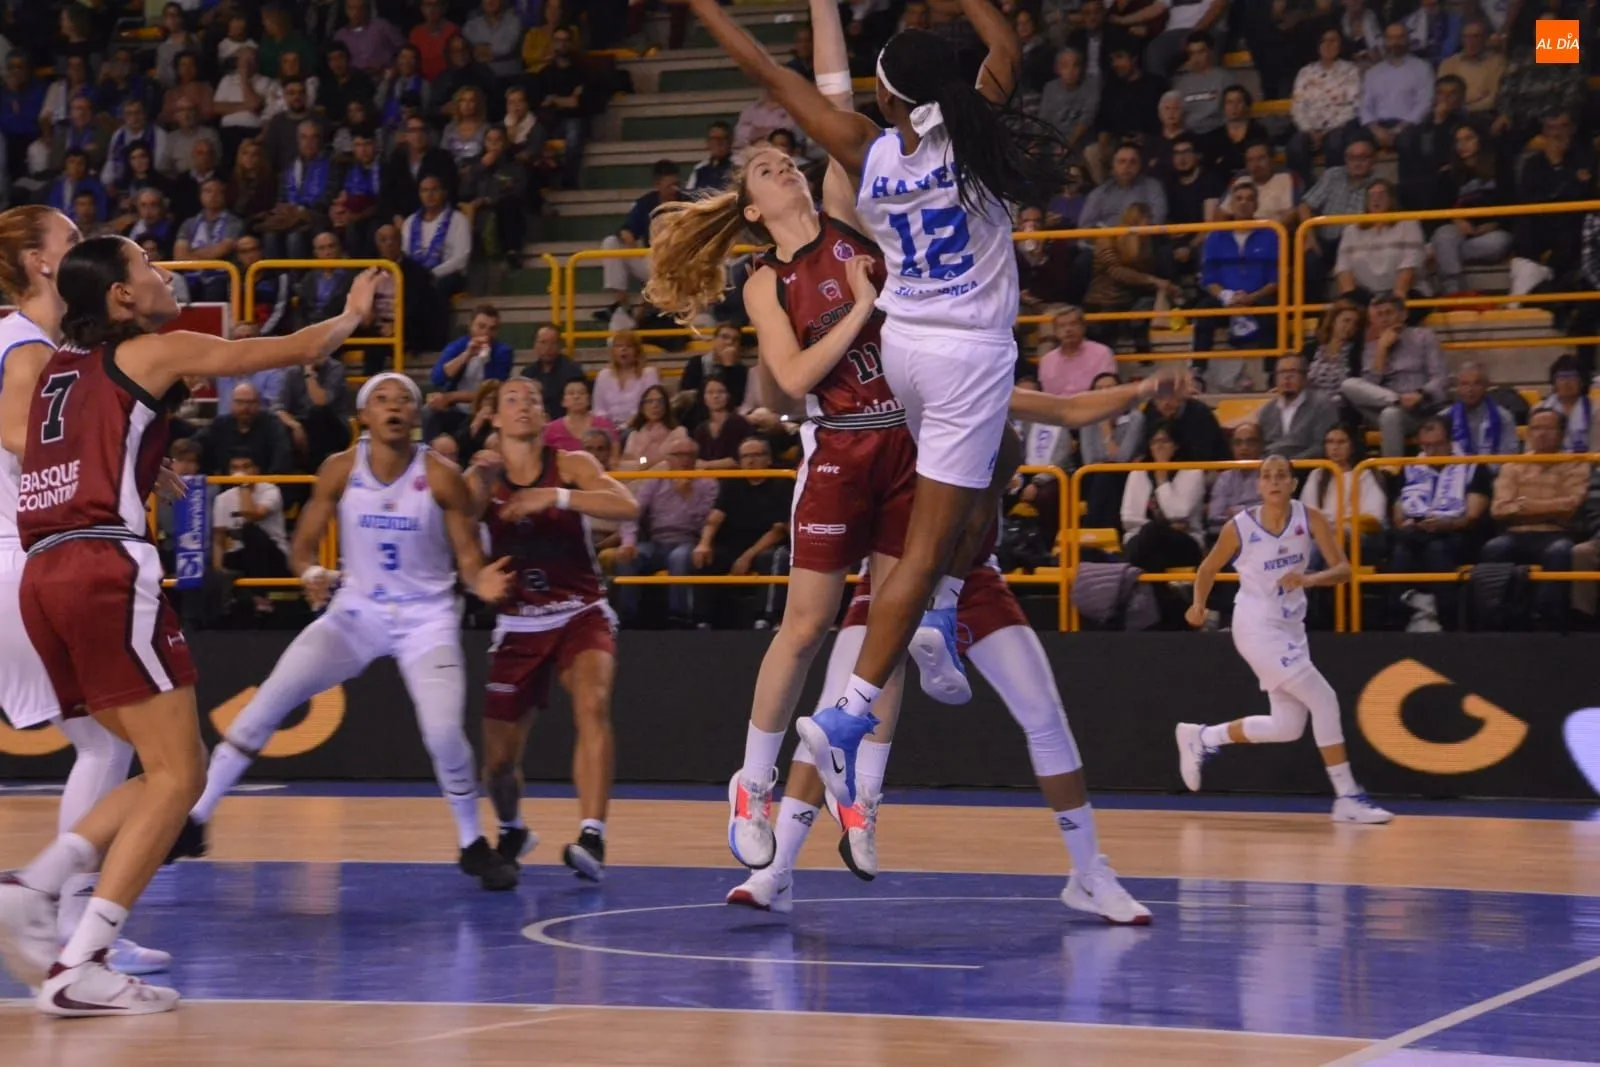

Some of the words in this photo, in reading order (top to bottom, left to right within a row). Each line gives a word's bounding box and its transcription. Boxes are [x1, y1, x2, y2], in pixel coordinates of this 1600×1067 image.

[889, 205, 974, 281] 12
[848, 342, 884, 384] 11
[41, 370, 80, 444] 7
[20, 459, 81, 492] BASQUE
[17, 481, 79, 512] COUNTRY
[378, 543, 399, 571] 3
[1264, 553, 1304, 571] AVENIDA
